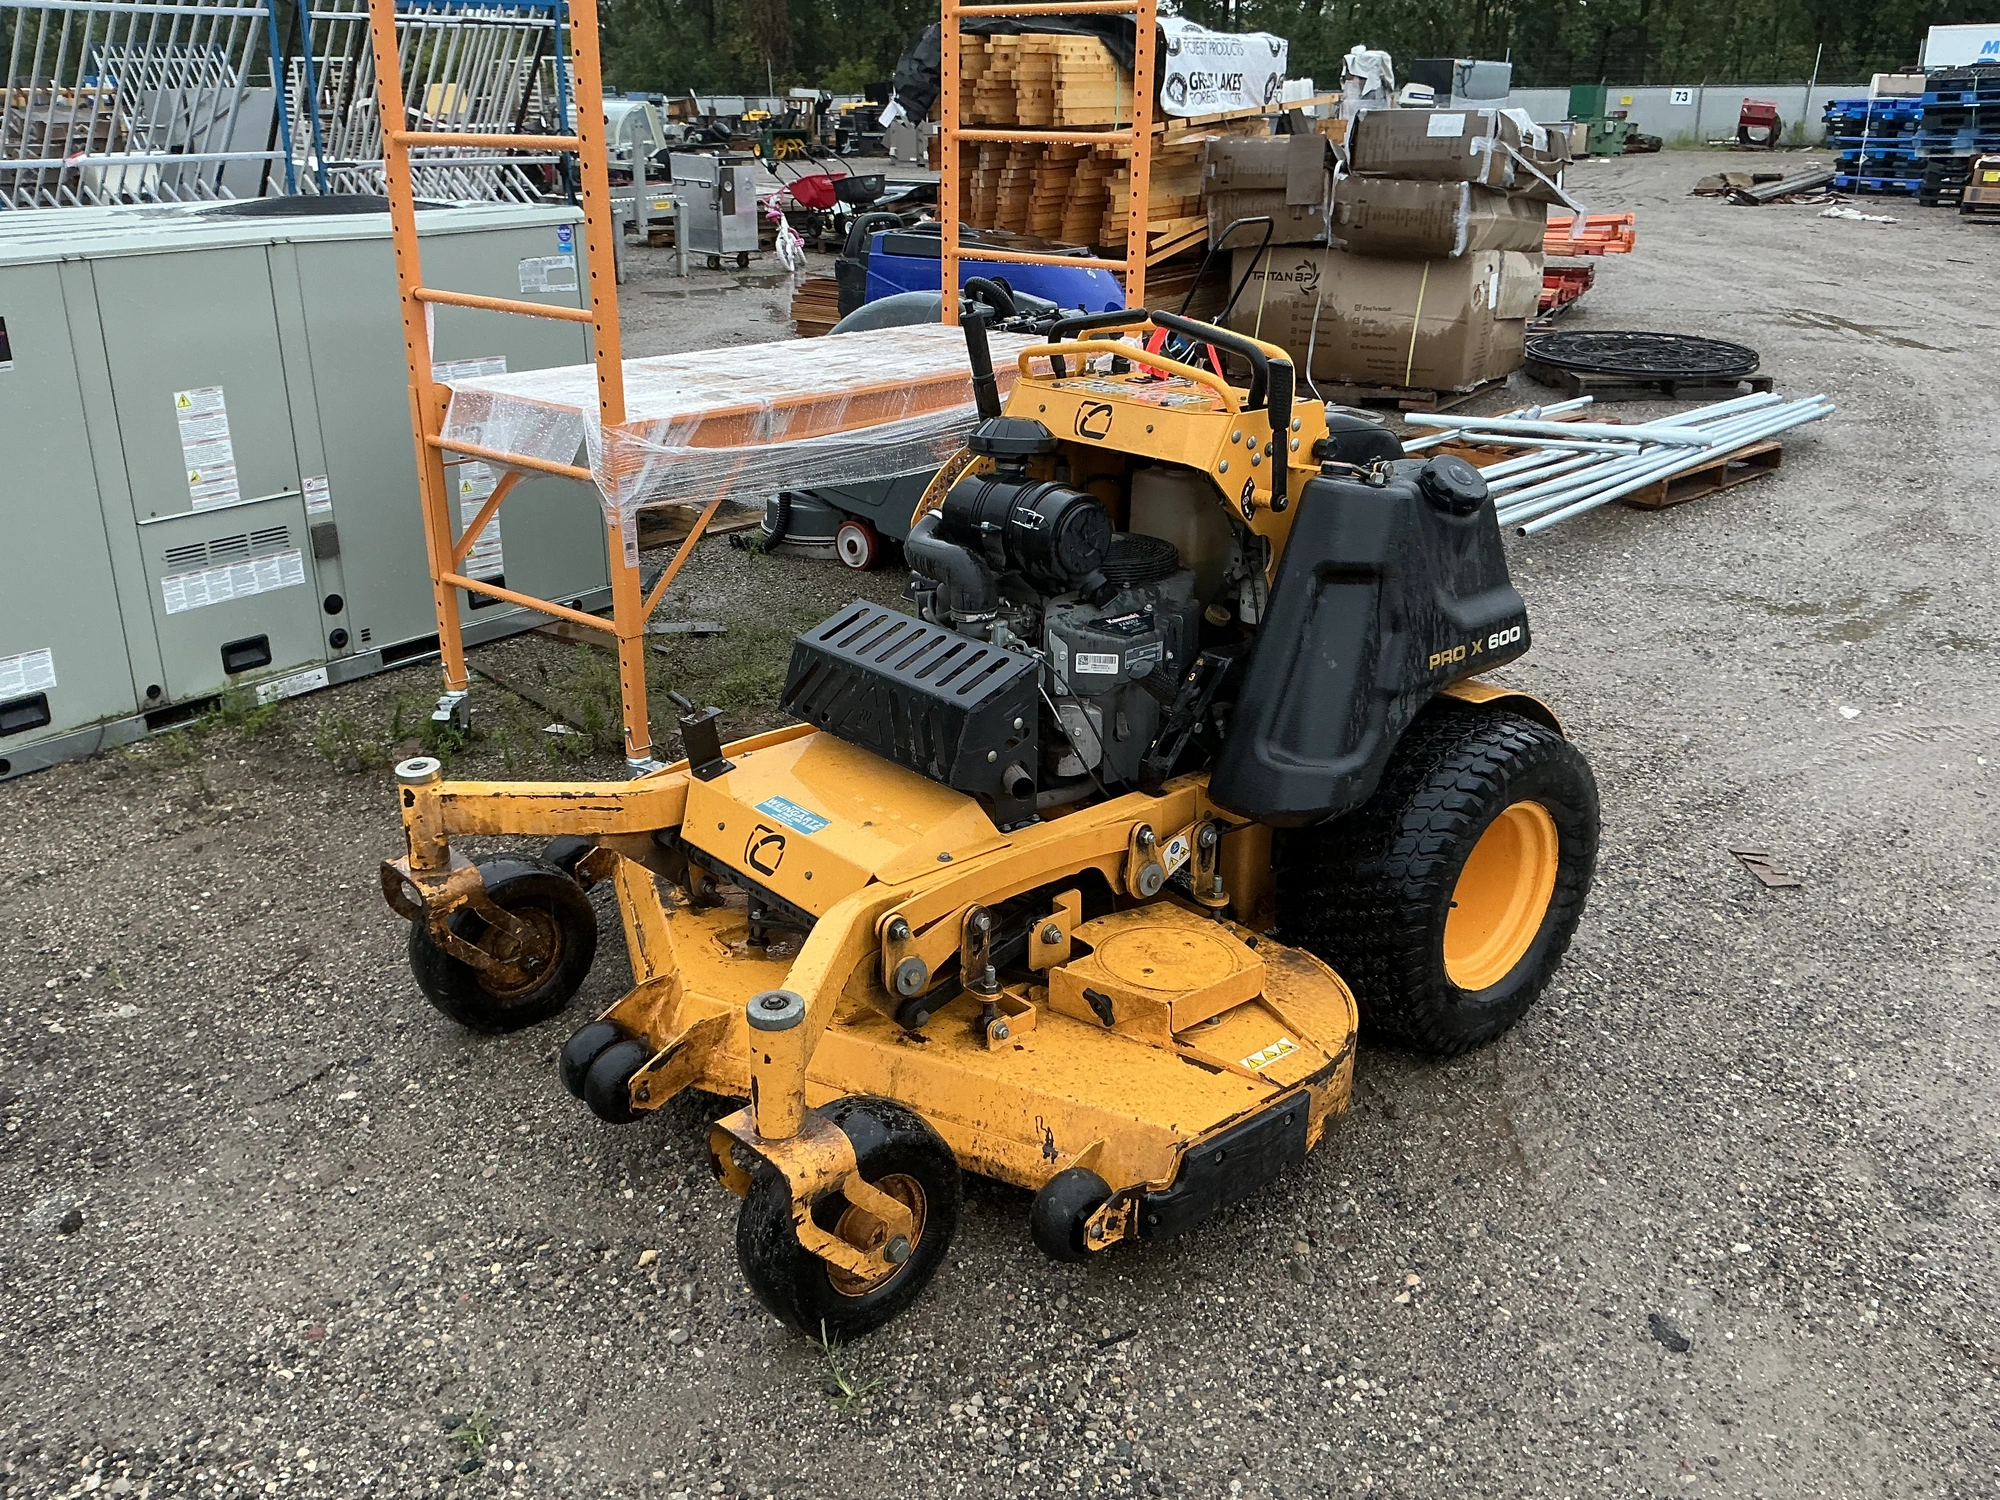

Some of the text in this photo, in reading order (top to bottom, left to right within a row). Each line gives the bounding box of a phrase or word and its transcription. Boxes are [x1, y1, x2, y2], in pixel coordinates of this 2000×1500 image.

[1189, 72, 1214, 91] GRET
[1215, 73, 1243, 91] LAKES
[1676, 92, 1688, 102] 73
[1251, 270, 1313, 283] TRITAN BP
[1429, 626, 1520, 671] PRO X 600
[1188, 672, 1196, 681] 3
[766, 798, 825, 829] WEINGARTZ
